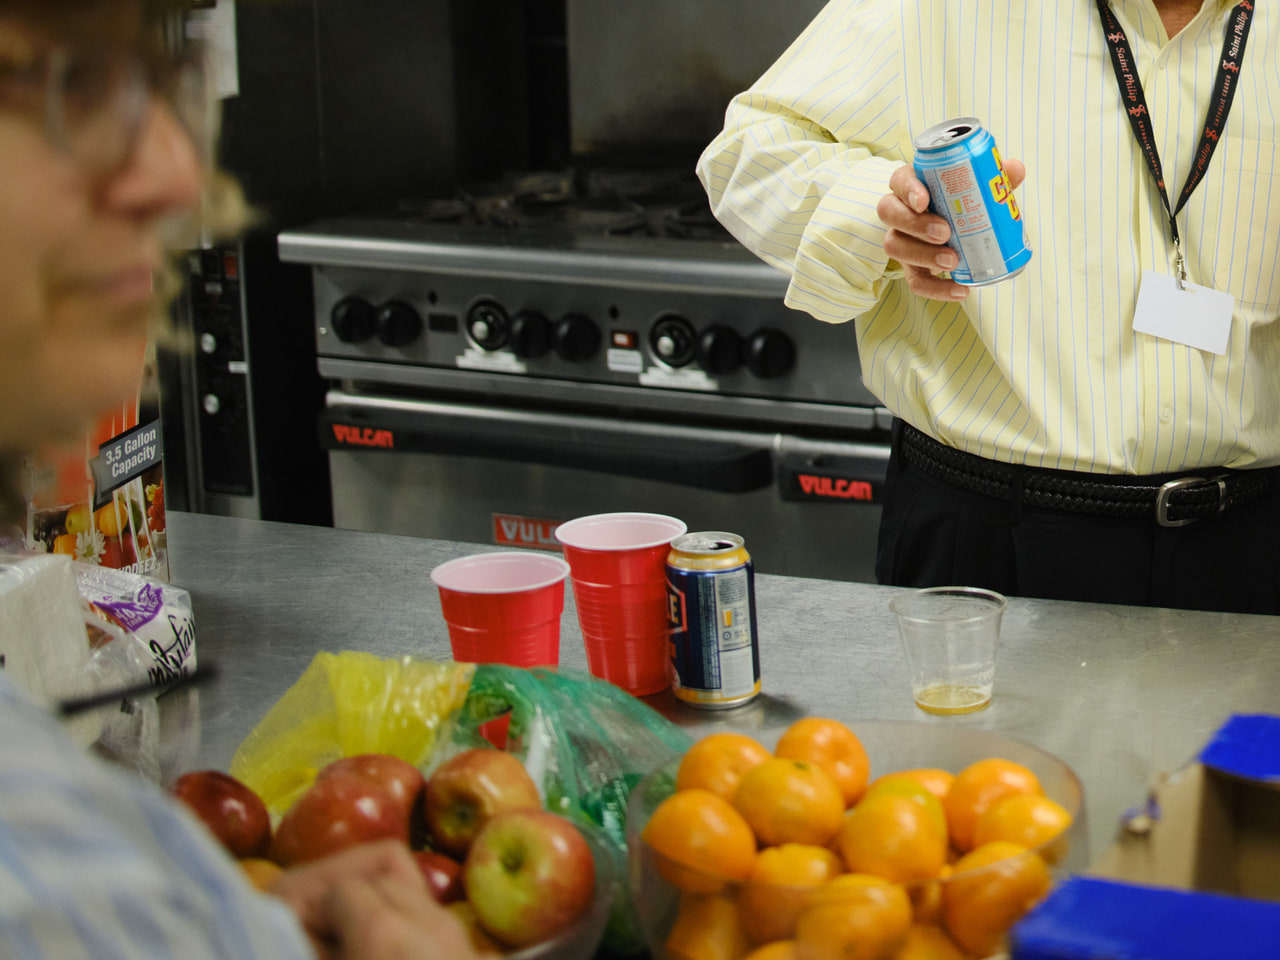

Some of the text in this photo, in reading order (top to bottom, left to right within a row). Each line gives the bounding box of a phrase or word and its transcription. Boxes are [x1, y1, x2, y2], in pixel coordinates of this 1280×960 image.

[1229, 11, 1248, 59] Saint Philip
[1115, 47, 1137, 102] Saint Philip
[1197, 143, 1211, 171] Philip
[105, 429, 157, 465] 3.5 Gallon
[331, 424, 394, 448] VULCAN
[112, 444, 156, 477] Capacity
[798, 474, 873, 500] VULCAN
